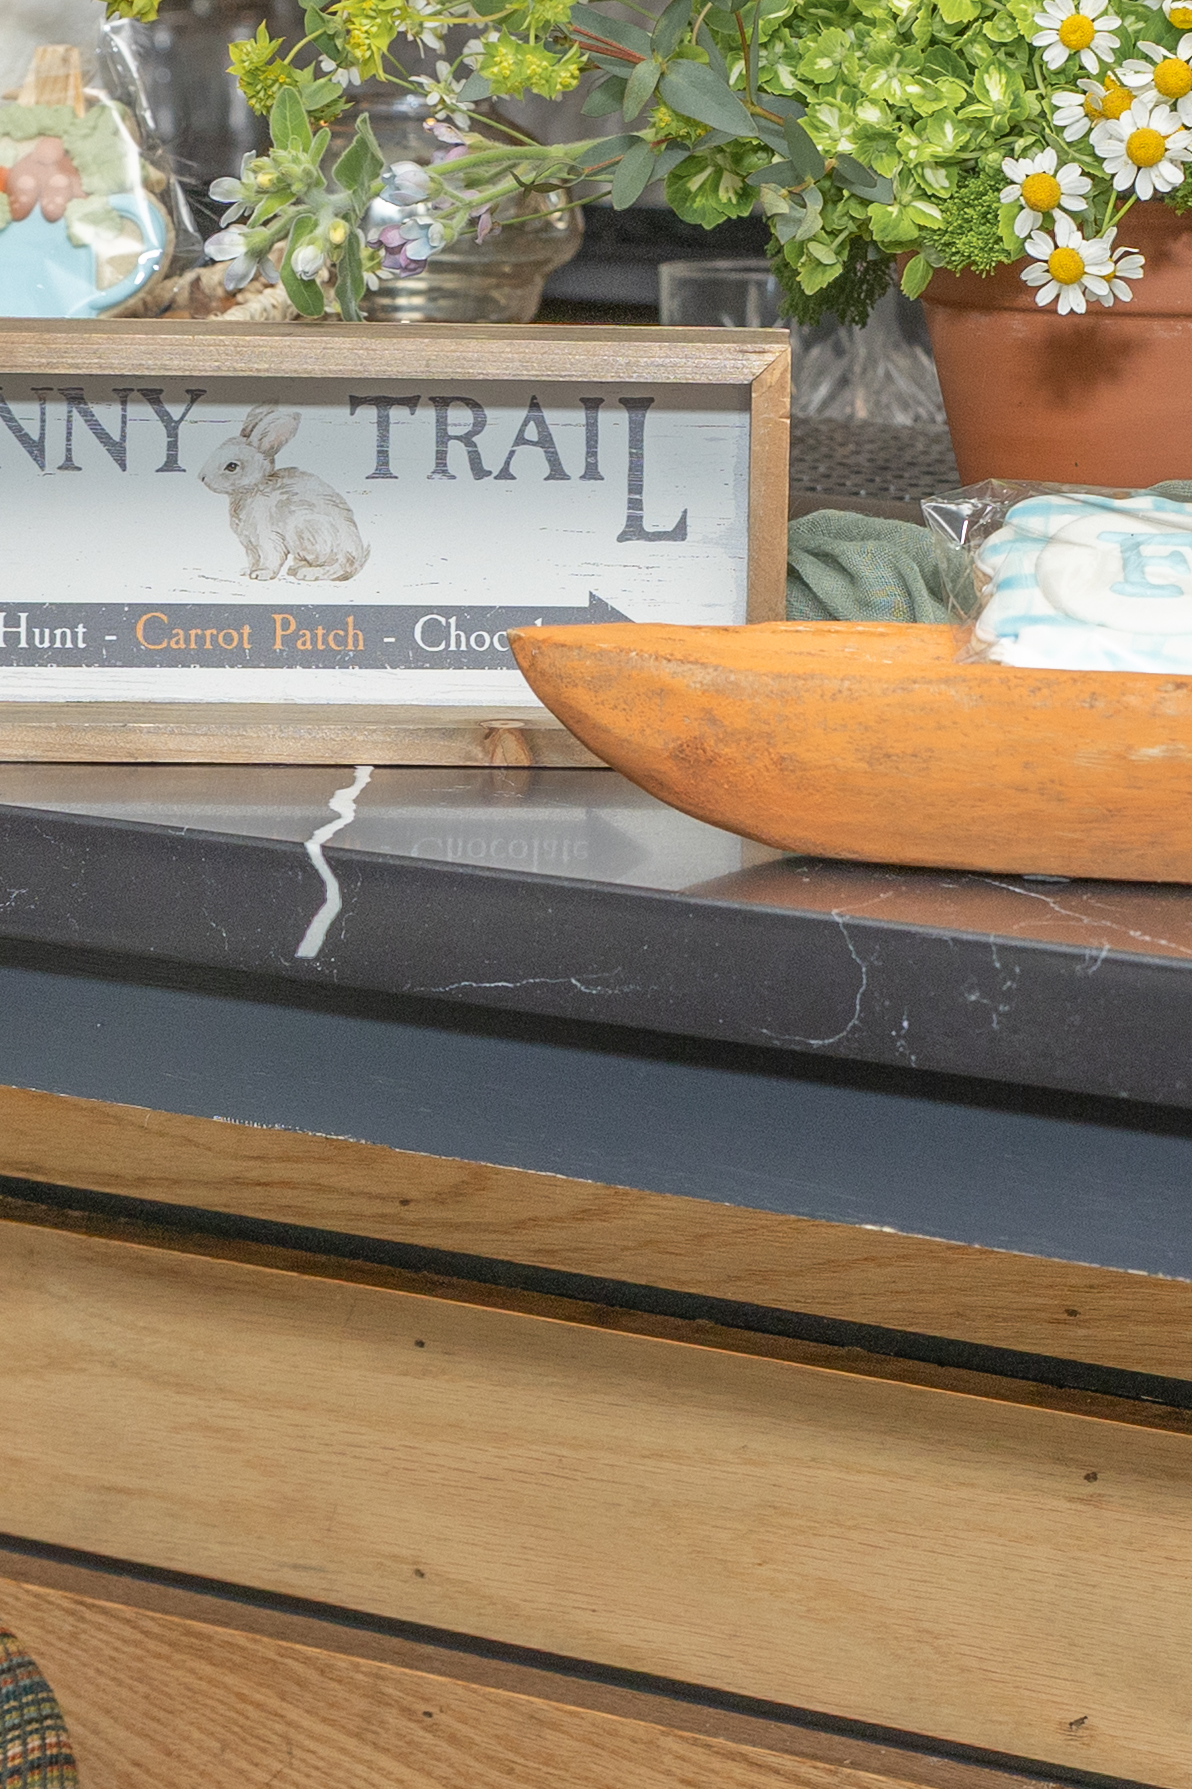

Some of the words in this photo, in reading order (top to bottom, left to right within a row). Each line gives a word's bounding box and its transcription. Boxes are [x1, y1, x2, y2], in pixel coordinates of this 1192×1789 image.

[0, 386, 208, 472] NNY
[349, 394, 688, 543] TRAIL
[0, 612, 88, 649] Hunt
[135, 612, 252, 649] Carrot
[272, 614, 365, 651] Patch
[414, 614, 543, 652] Choc
